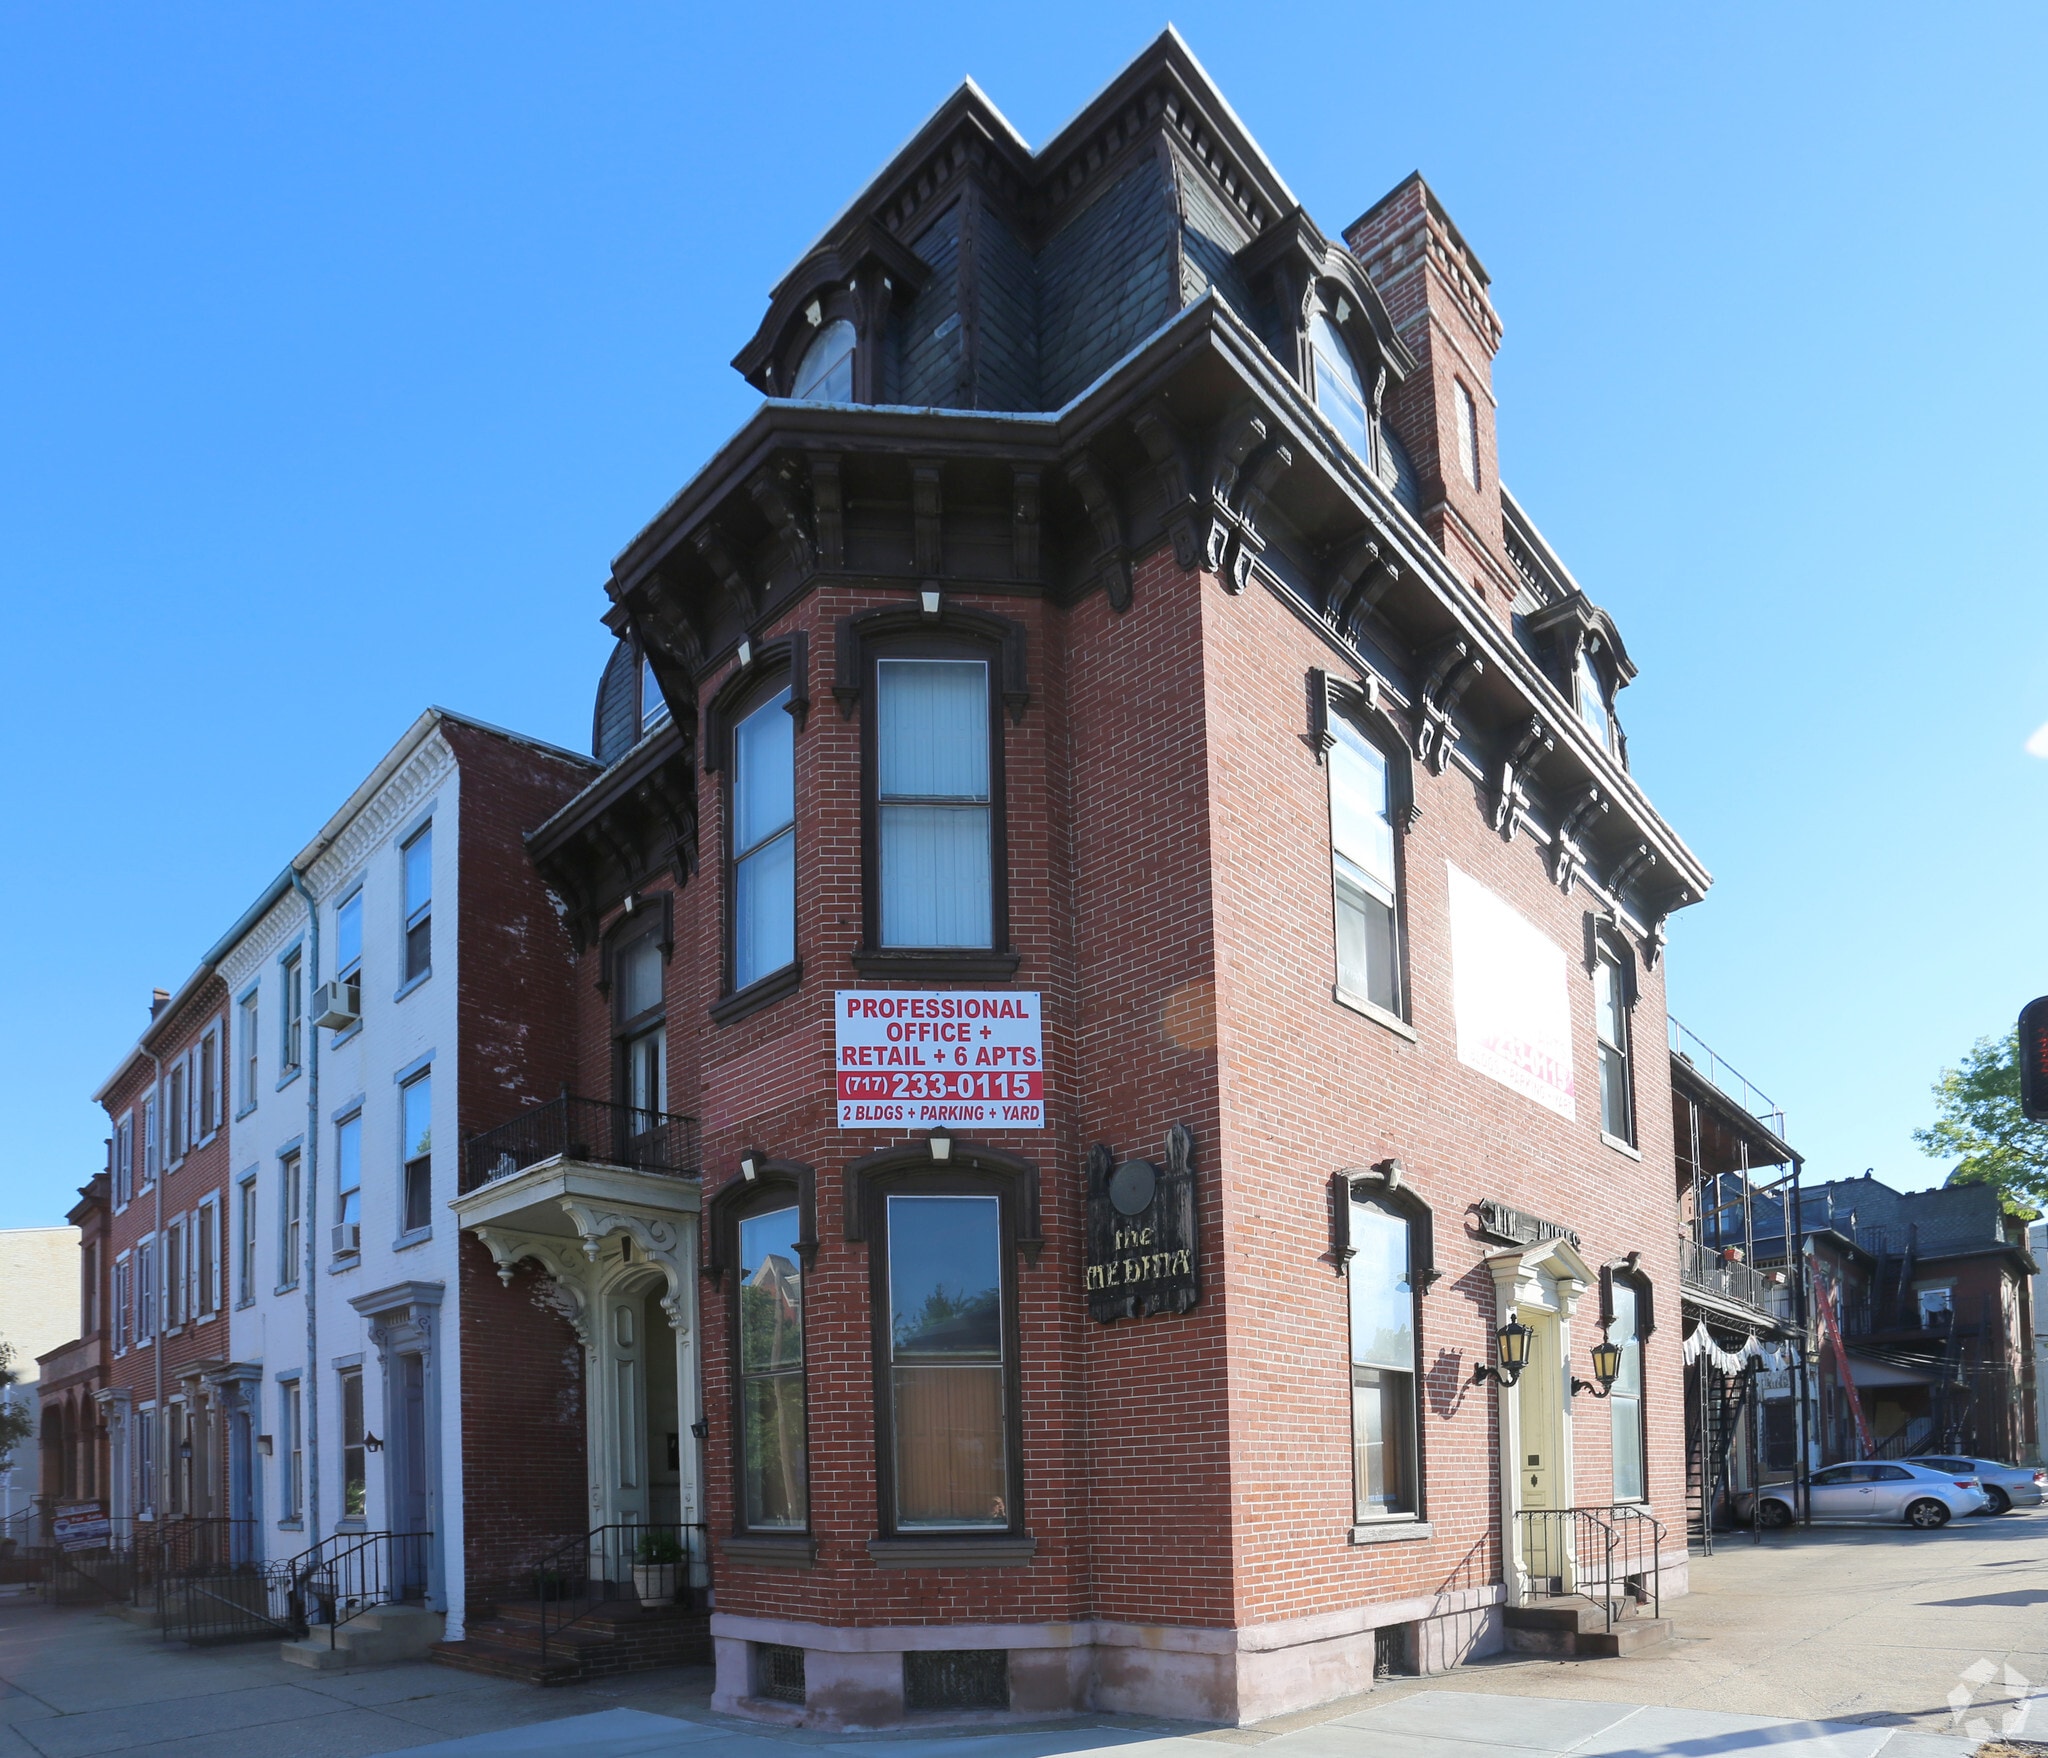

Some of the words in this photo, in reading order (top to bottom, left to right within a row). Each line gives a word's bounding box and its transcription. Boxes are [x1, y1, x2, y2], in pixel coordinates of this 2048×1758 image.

[847, 998, 1029, 1019] PROFESSIONAL
[886, 1022, 972, 1042] OFFICE
[980, 1025, 992, 1040] +
[842, 1046, 926, 1066] RETAIL
[934, 1049, 946, 1063] +
[954, 1046, 968, 1067] 6
[975, 1046, 1037, 1067] APTS
[845, 1076, 888, 1095] (717)
[891, 1073, 1031, 1099] 233-0115
[843, 1105, 851, 1121] 2
[855, 1105, 904, 1121] BLDGS
[908, 1108, 916, 1119] +
[920, 1105, 984, 1121] PARKING
[989, 1108, 997, 1119] +
[1002, 1105, 1040, 1121] YARD
